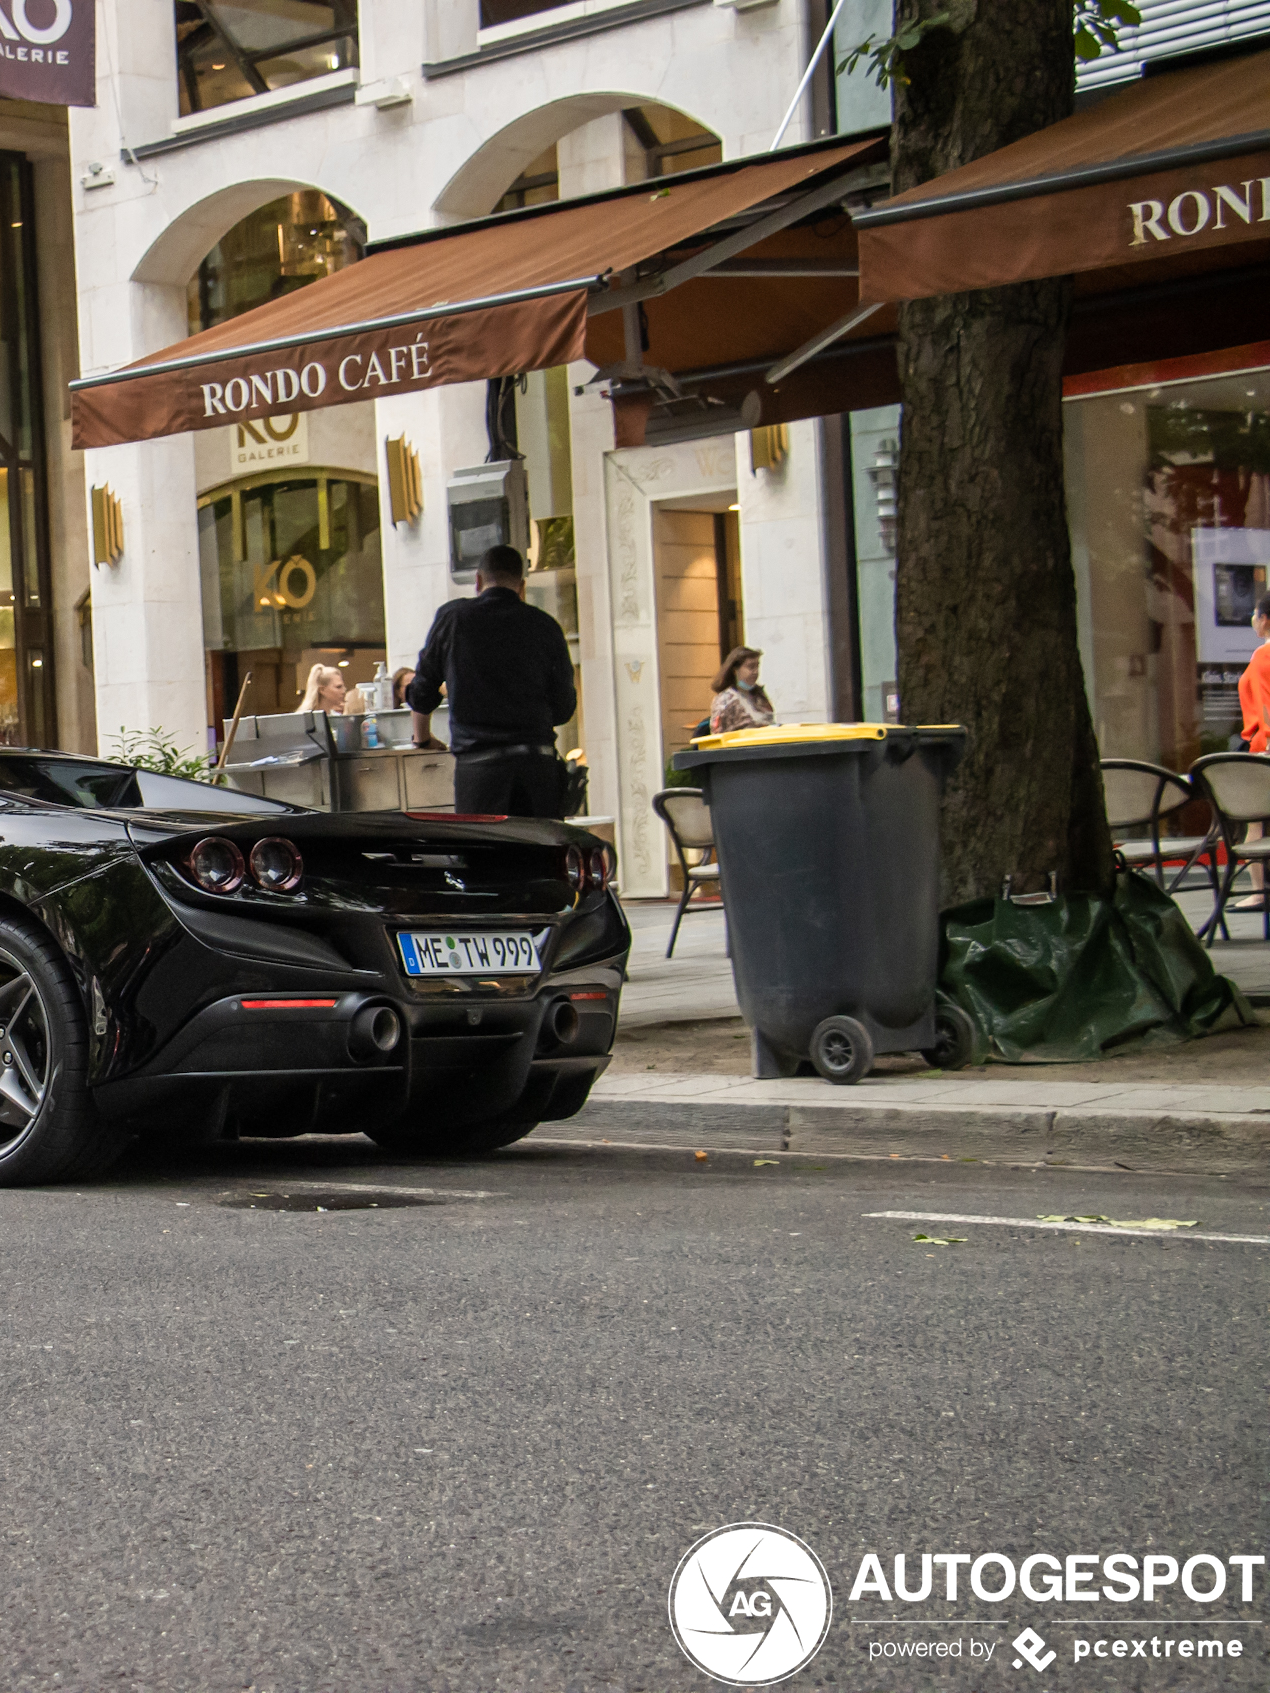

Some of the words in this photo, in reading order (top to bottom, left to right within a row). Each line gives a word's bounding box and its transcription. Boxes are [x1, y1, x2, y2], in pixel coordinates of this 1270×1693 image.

[200, 362, 327, 417] RONDO
[338, 332, 433, 391] CAFÉ
[238, 443, 300, 464] GALERIE
[492, 936, 533, 967] 999
